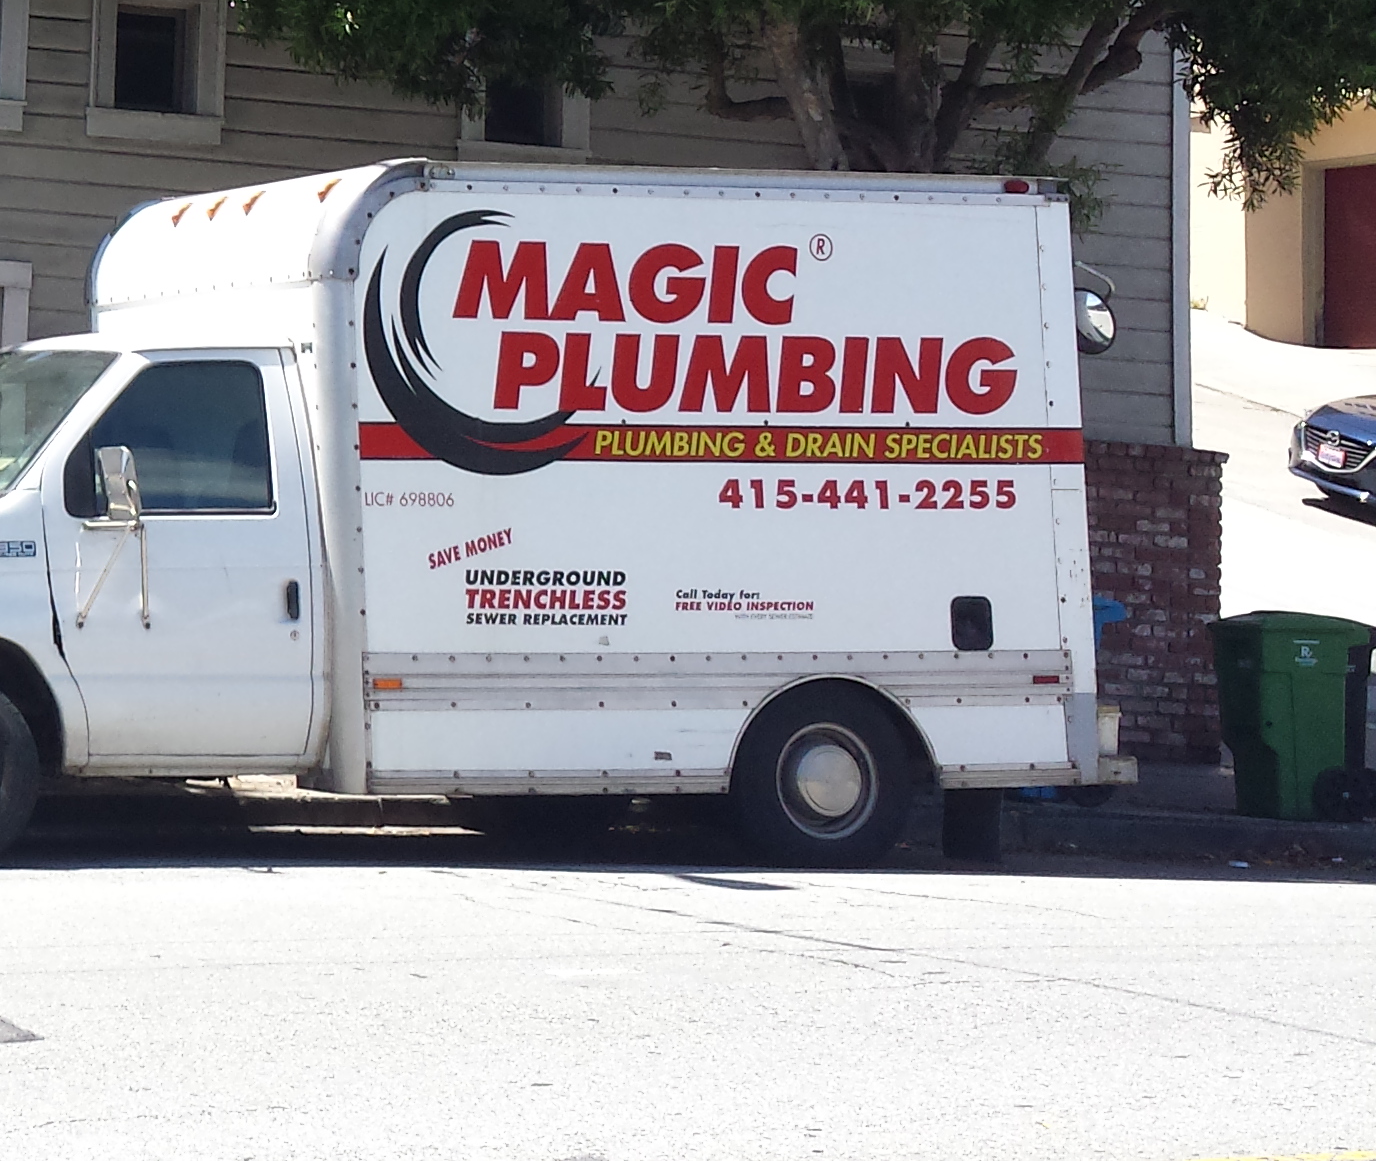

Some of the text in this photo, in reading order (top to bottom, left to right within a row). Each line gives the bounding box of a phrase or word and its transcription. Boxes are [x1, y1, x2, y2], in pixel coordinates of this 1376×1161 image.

[452, 240, 798, 325] MAGIC
[493, 332, 1018, 416] PLUMBING
[594, 430, 1043, 459] PLUMBING & DRAIN SPECIALISTS
[364, 492, 455, 507] LIC# 698806
[717, 478, 1017, 510] 415-441-2255
[428, 527, 513, 570] SAVE MONEY
[465, 569, 627, 587] UNDERGROUND
[465, 588, 628, 610] TRENCHLESS
[675, 589, 698, 599] Call
[701, 589, 736, 602] Today
[675, 601, 815, 611] FREE VIDEO INSPECTION
[465, 612, 628, 627] SEWER REPLACEMENT
